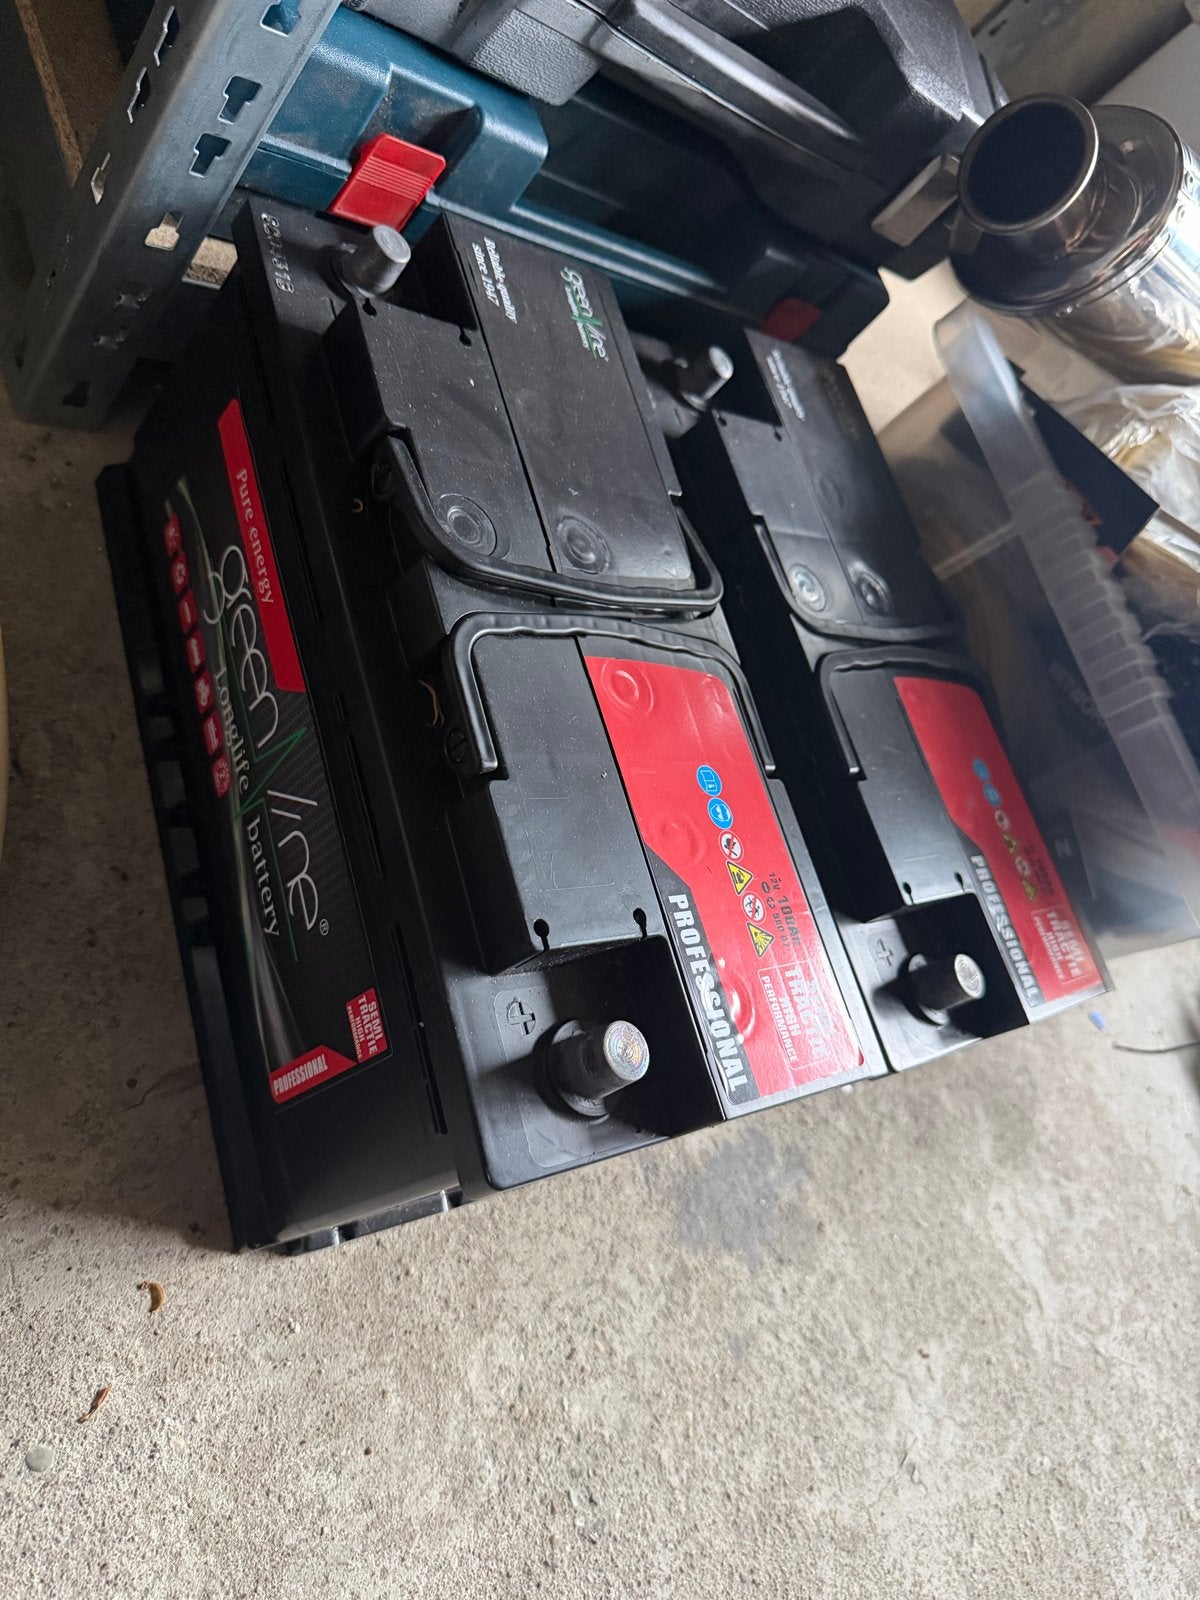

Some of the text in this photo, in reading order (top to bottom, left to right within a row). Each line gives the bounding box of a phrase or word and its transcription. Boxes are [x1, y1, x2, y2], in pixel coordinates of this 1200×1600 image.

[471, 242, 500, 307] since 1947
[484, 236, 517, 324] Reliable quality
[236, 468, 274, 604] Pure energy
[214, 668, 250, 794] Longlife
[246, 815, 280, 936] battery
[768, 871, 780, 891] 12V
[970, 854, 1041, 1002] PROFESSIONAL
[1046, 911, 1083, 978] TRACTIE
[1048, 931, 1064, 962] HIGH
[1059, 918, 1087, 964] SEMI
[367, 1000, 384, 1041] SEMI
[667, 893, 749, 1092] PROFESSIONAL
[761, 974, 799, 1063] PERFORMANCE
[779, 996, 802, 1037] HIGH
[346, 1004, 363, 1059] PERFORMANCE
[354, 1016, 366, 1047] HIGH
[358, 994, 379, 1055] TRACTIE
[272, 1053, 329, 1096] PROFESSIONAL
